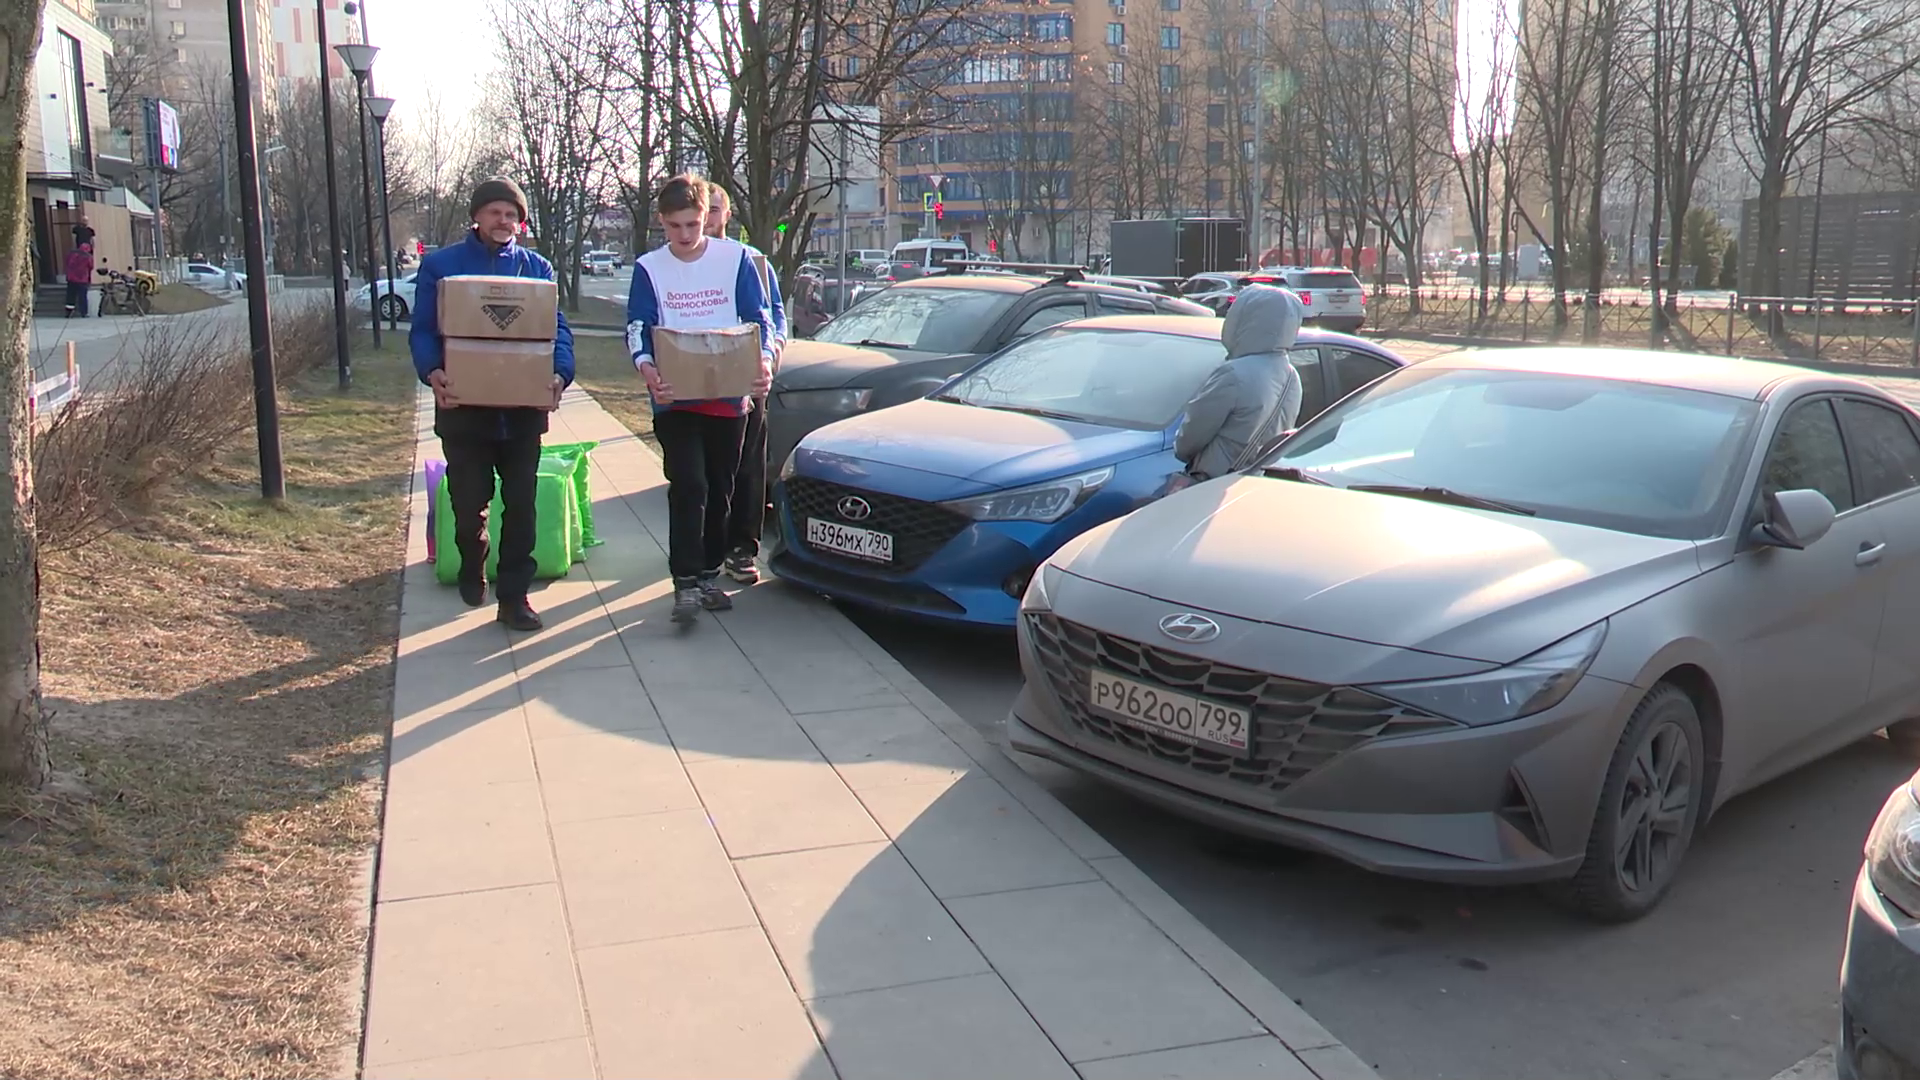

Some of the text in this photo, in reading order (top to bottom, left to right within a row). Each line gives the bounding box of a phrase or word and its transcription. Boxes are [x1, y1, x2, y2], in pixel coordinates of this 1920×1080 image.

[868, 531, 889, 551] 790
[1199, 703, 1242, 736] 799
[1208, 730, 1229, 744] RUS
